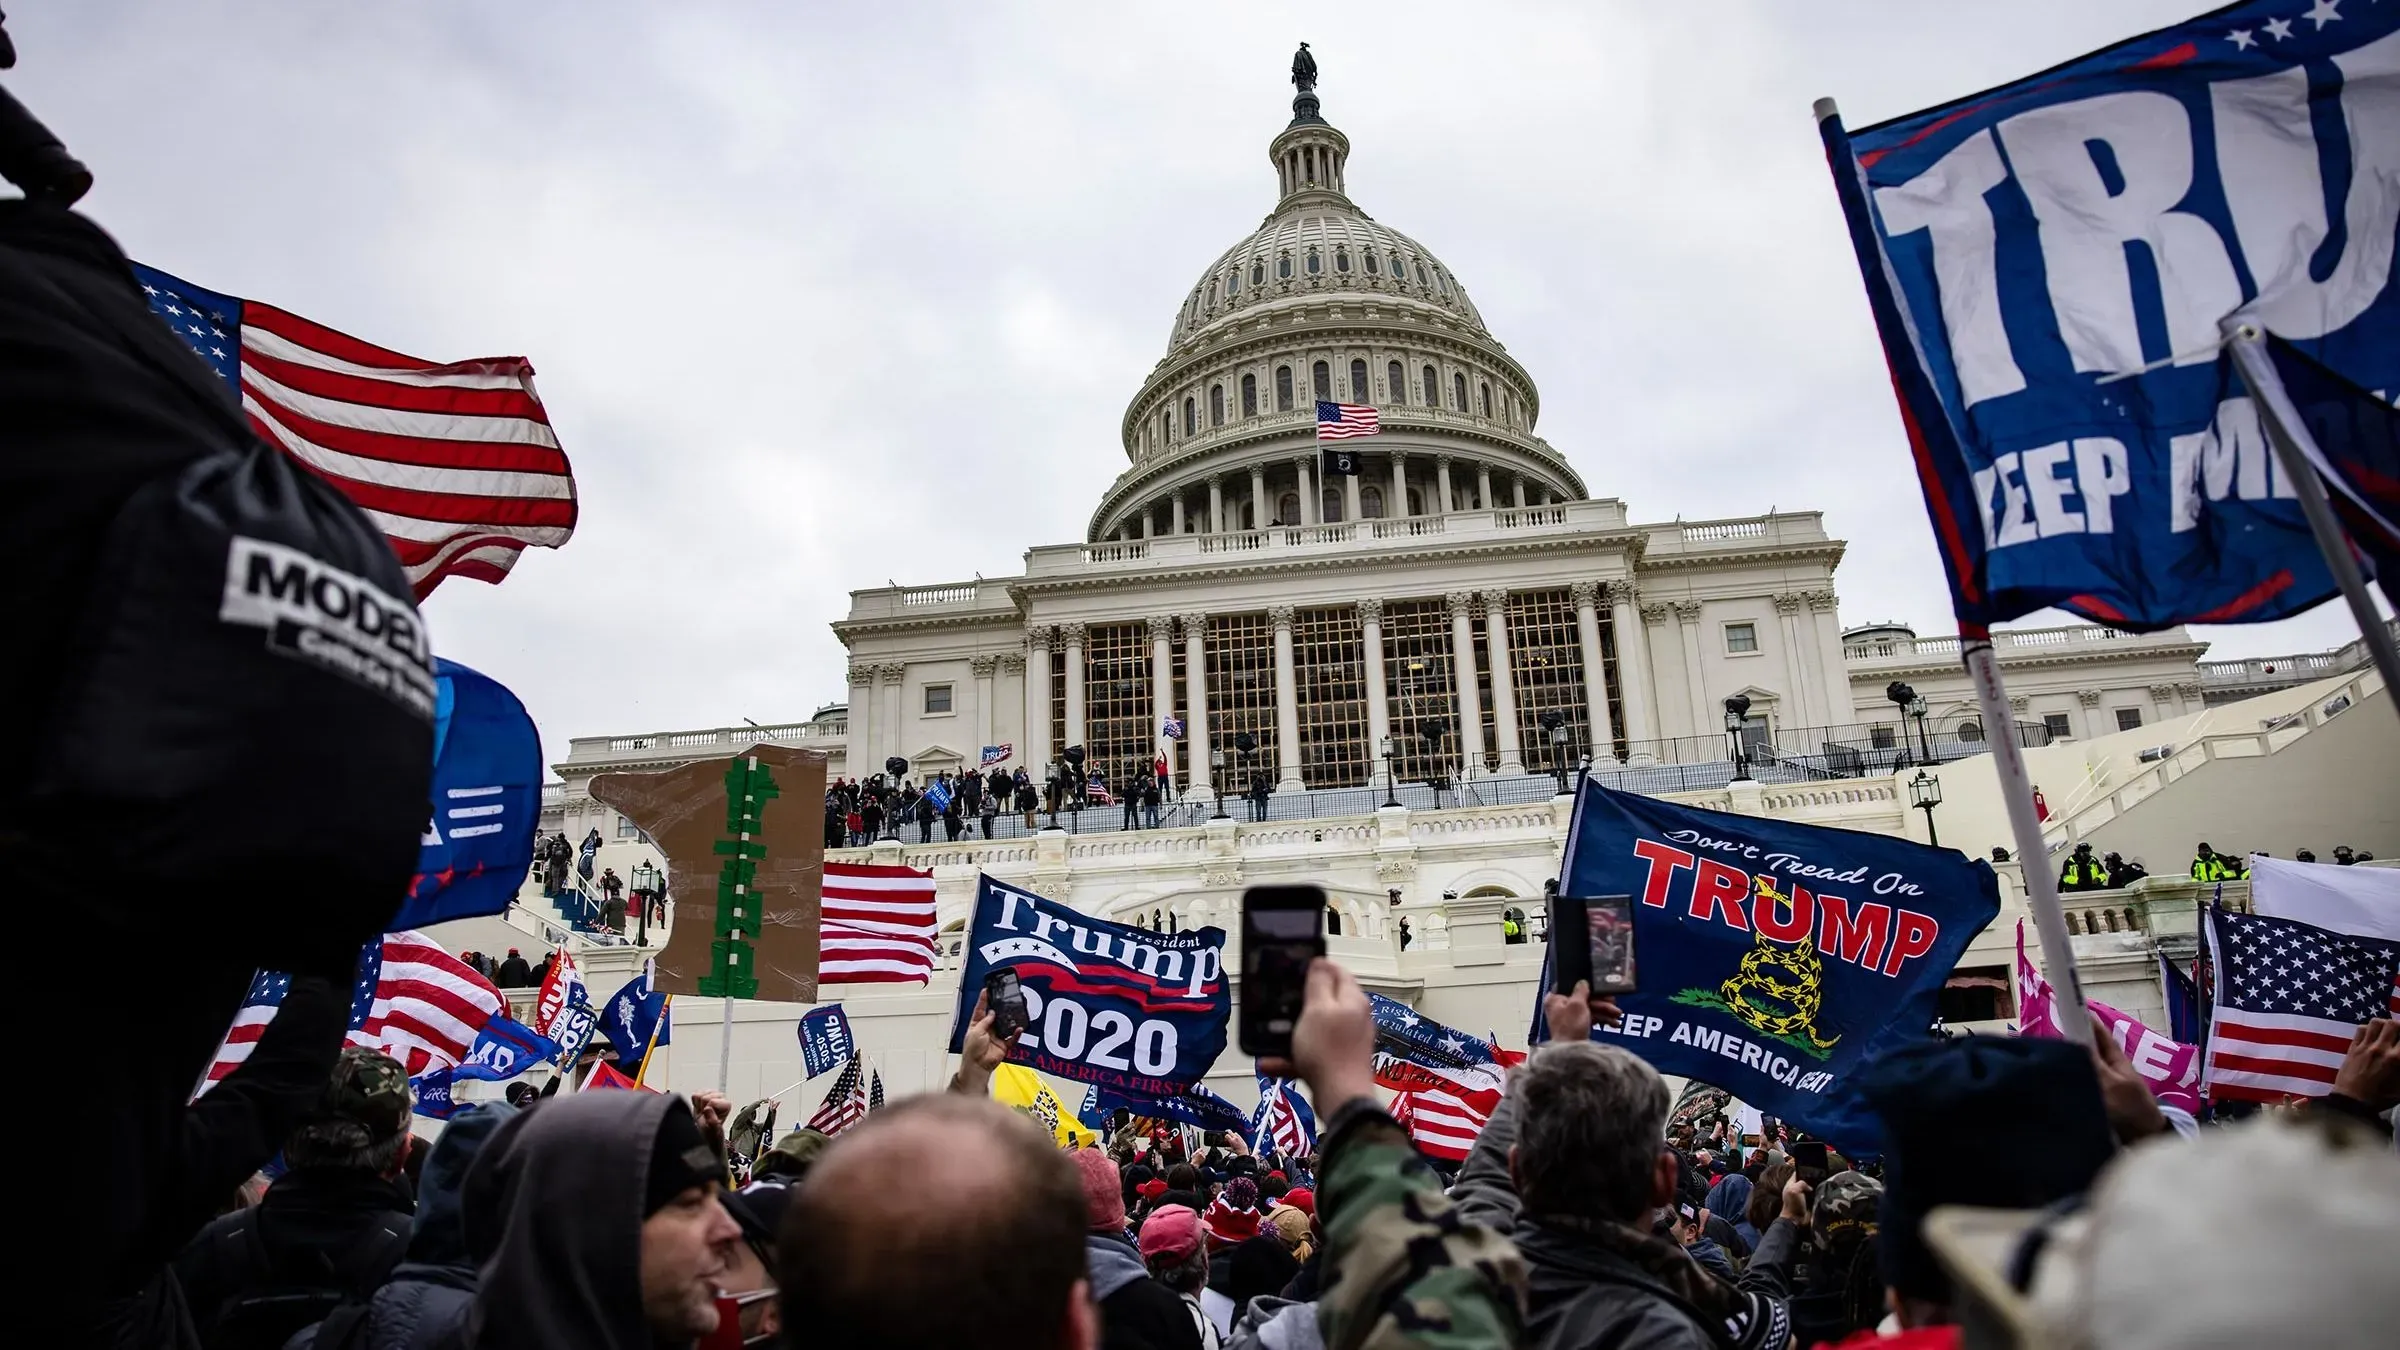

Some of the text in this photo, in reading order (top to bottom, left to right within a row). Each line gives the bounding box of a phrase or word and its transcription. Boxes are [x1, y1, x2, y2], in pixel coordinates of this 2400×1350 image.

[246, 551, 432, 674] MODE
[1633, 838, 1939, 978] TRUMP
[1663, 828, 1924, 897] Don't Tread On
[990, 884, 1221, 998] Trump
[1016, 985, 1178, 1077] 2020
[1035, 1054, 1131, 1086] AMERICA
[1131, 1076, 1189, 1096] FIRST
[1592, 1012, 1663, 1038] EEP
[1669, 1021, 1800, 1087] AMERICA
